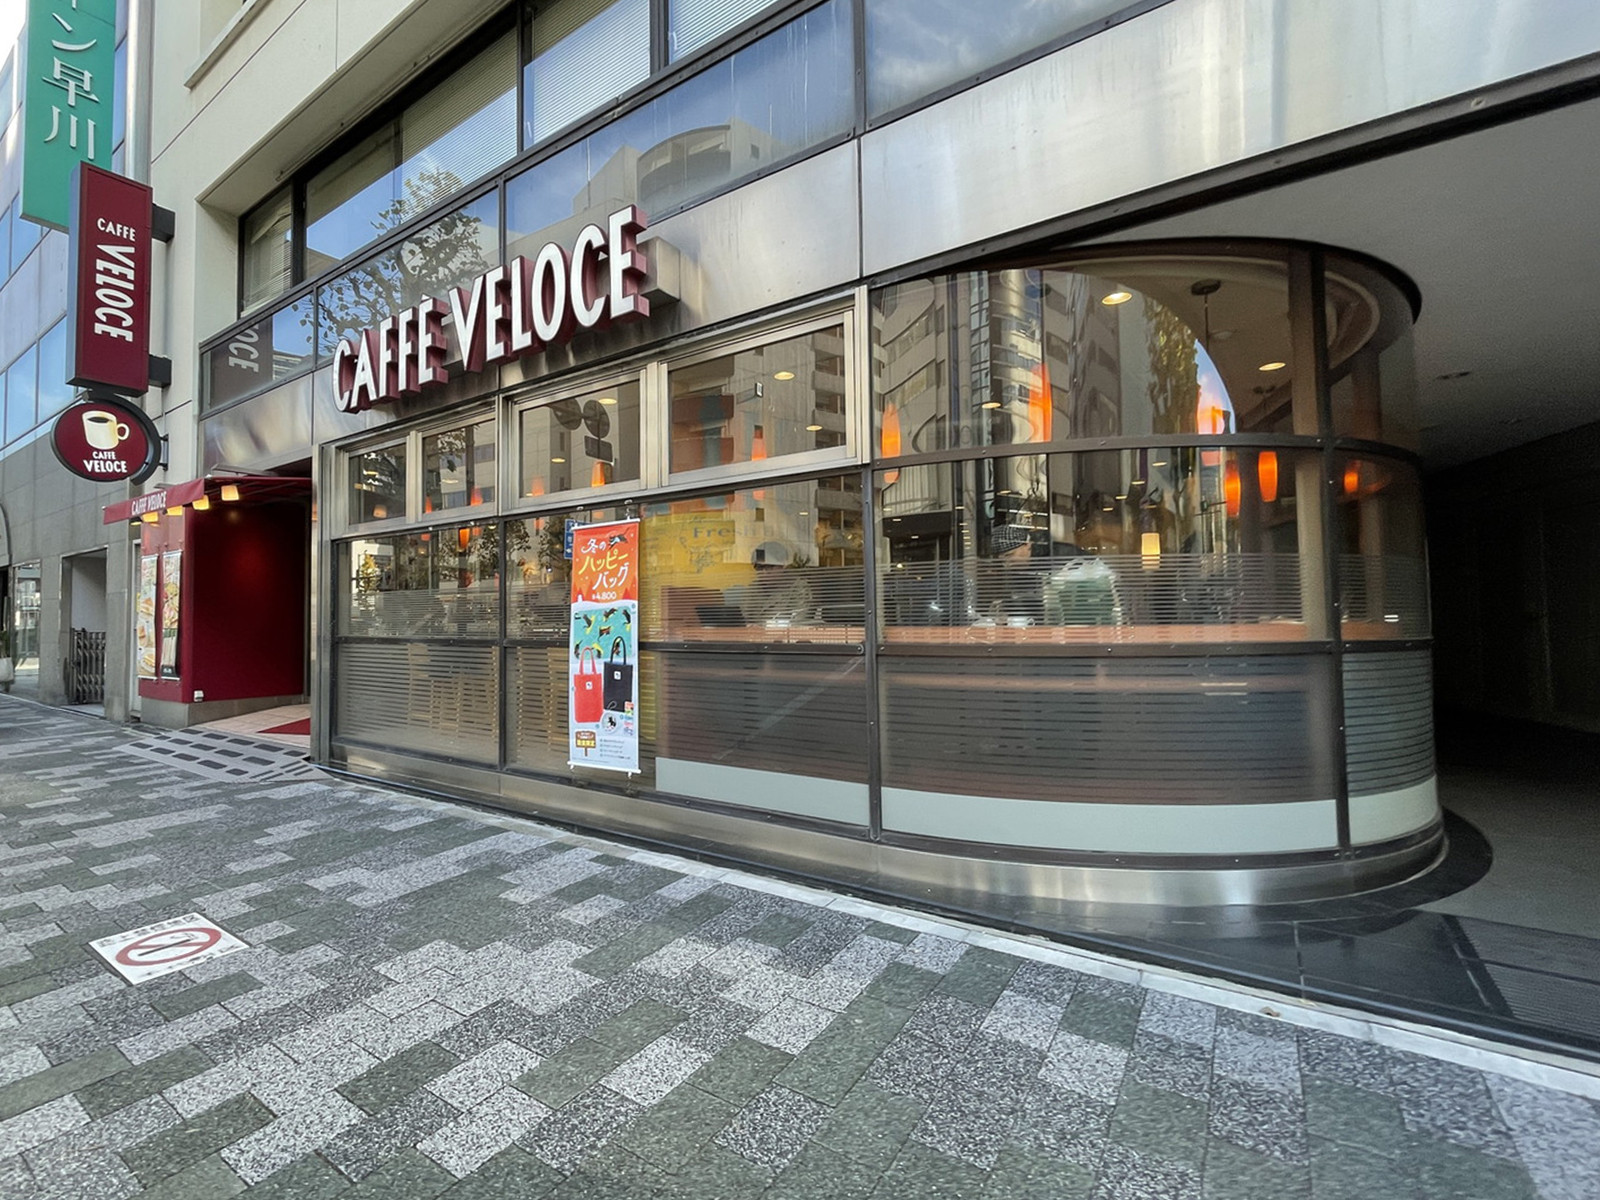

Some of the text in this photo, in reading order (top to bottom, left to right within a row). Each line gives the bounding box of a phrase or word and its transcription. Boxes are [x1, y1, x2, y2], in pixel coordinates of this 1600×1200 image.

[94, 244, 135, 342] VELOCE
[449, 203, 643, 372] VELOCE
[83, 460, 128, 473] VELOCE
[581, 538, 607, 554] 冬の
[578, 549, 629, 575] ハッピー
[592, 562, 630, 590] バッグ
